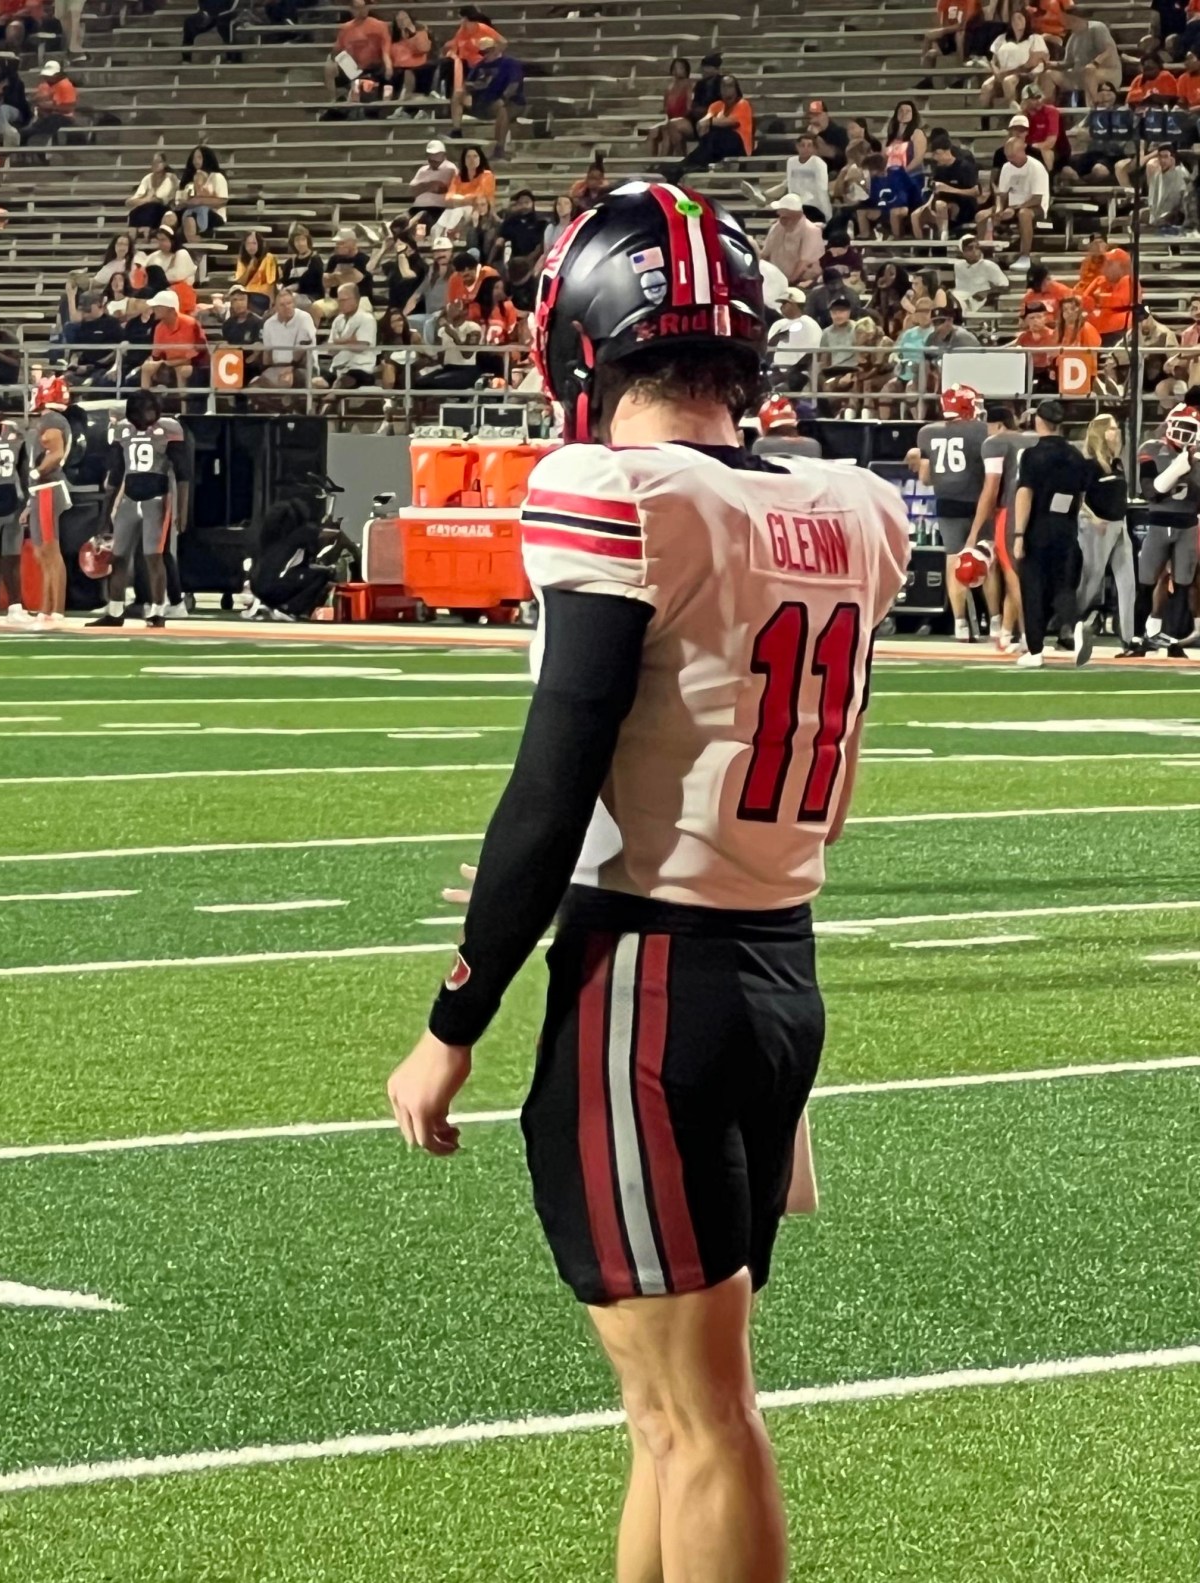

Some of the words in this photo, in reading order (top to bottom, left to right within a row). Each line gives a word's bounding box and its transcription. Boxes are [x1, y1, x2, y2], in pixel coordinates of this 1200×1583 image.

[218, 353, 239, 385] C
[1063, 357, 1087, 390] D
[128, 443, 154, 472] 19
[930, 437, 967, 473] 76
[766, 513, 849, 574] GLENN
[736, 601, 860, 823] 11
